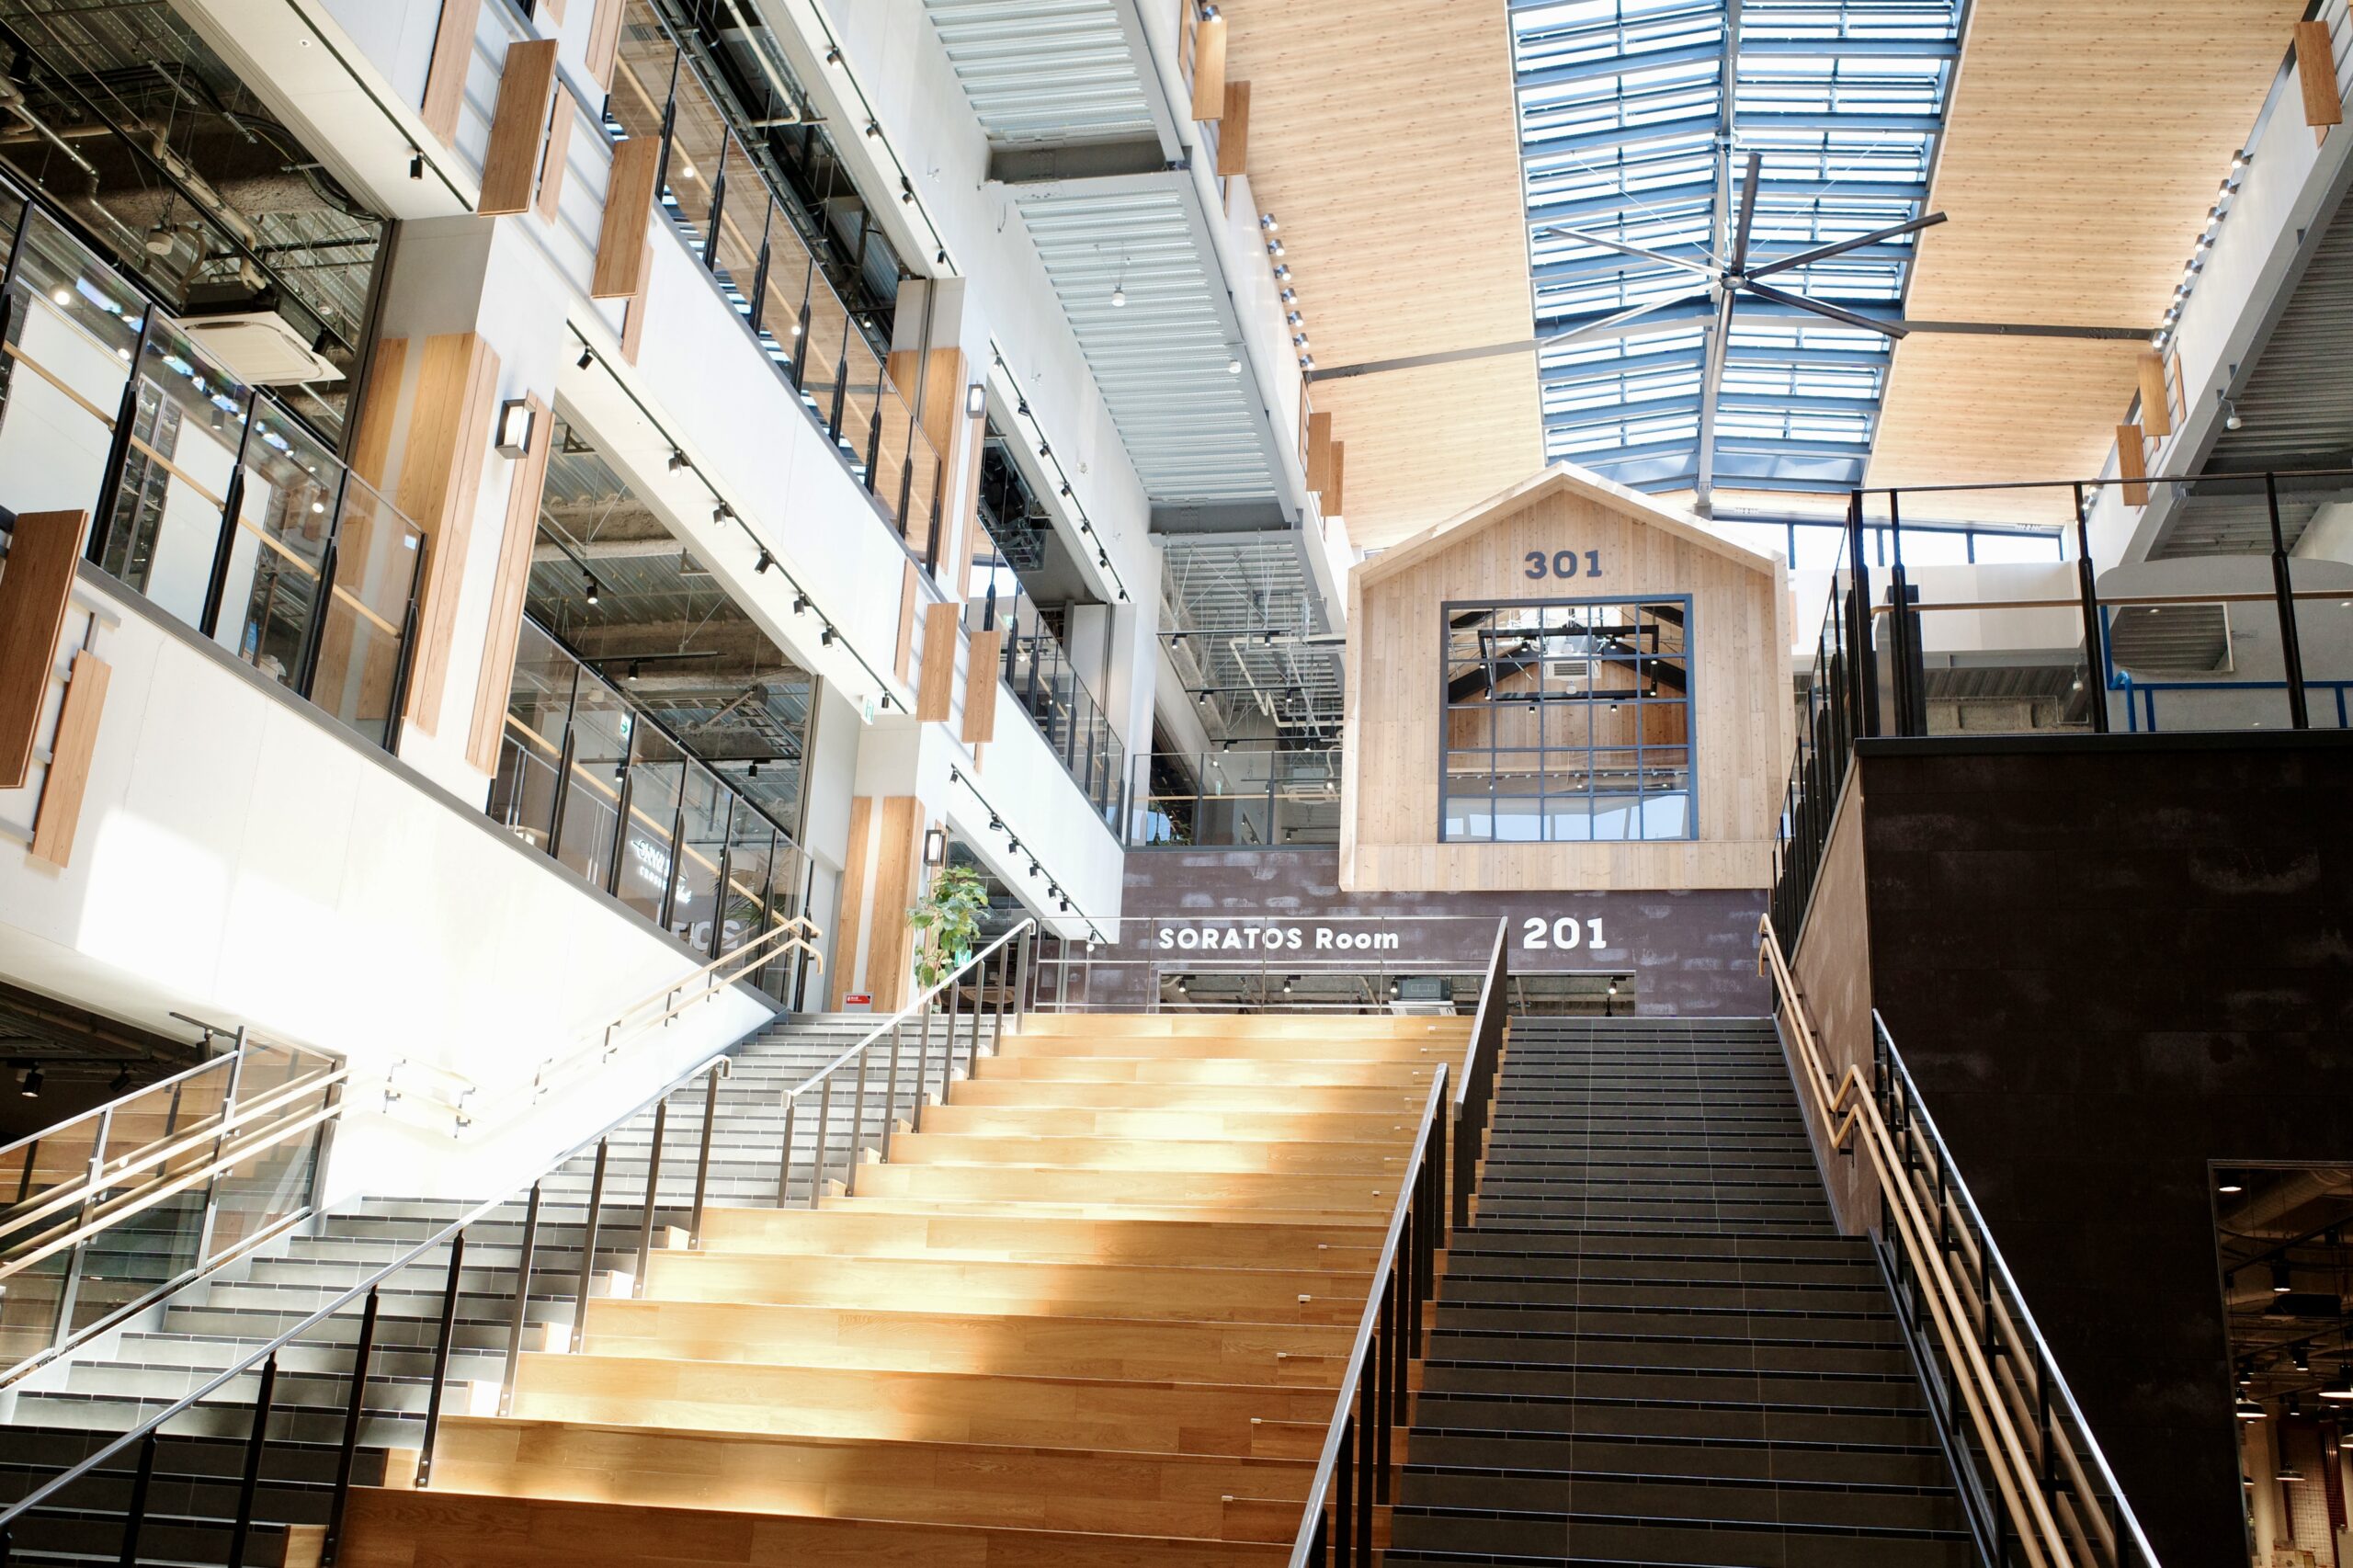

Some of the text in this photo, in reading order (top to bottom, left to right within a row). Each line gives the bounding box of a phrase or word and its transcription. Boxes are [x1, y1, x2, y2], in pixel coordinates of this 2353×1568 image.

[1525, 550, 1602, 579] 301
[1159, 927, 1399, 949] SORATOS Room
[1523, 917, 1607, 949] 201
